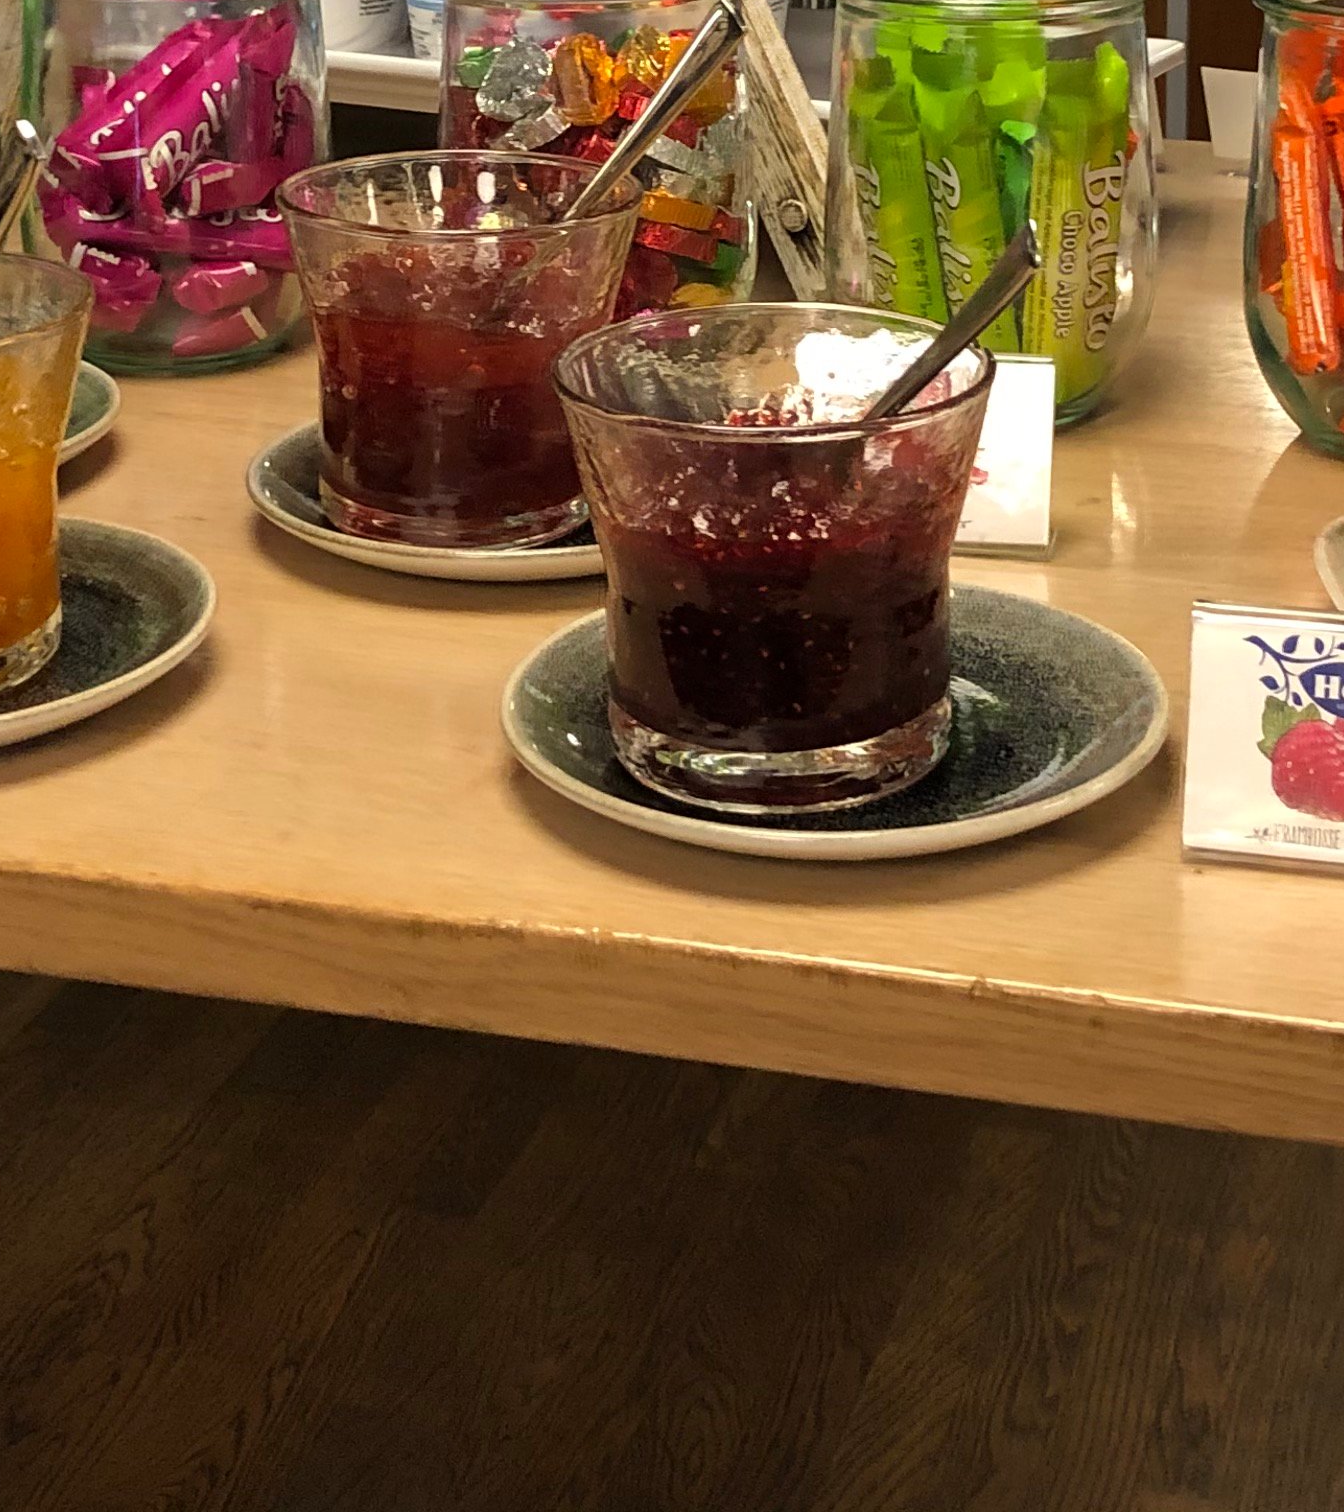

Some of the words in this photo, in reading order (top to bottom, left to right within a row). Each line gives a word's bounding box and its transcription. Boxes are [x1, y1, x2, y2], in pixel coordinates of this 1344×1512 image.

[150, 80, 242, 198] Bali
[855, 157, 898, 305] Balis
[925, 156, 973, 310] Balis
[1059, 209, 1084, 276] Choco
[1083, 149, 1126, 351] Balisto
[1051, 280, 1077, 340] Apple
